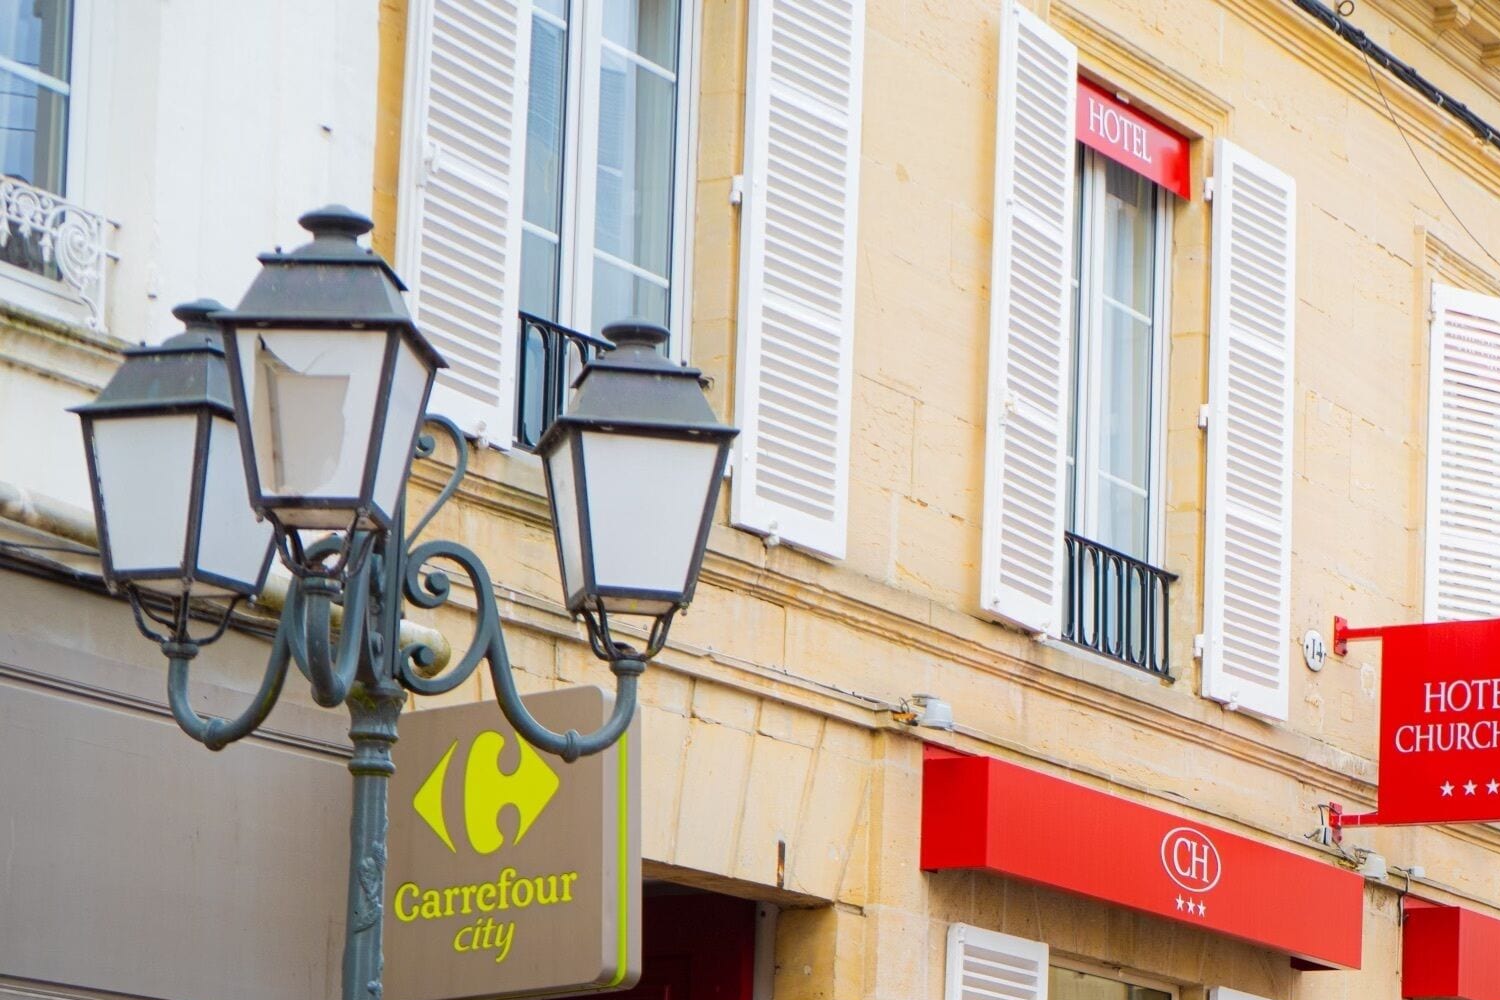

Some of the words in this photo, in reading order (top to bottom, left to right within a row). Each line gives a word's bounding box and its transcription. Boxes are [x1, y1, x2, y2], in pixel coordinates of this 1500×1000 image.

[1088, 97, 1152, 163] HOTEL
[1172, 836, 1210, 883] CH
[394, 867, 578, 922] Carrefour
[453, 917, 515, 963] city
